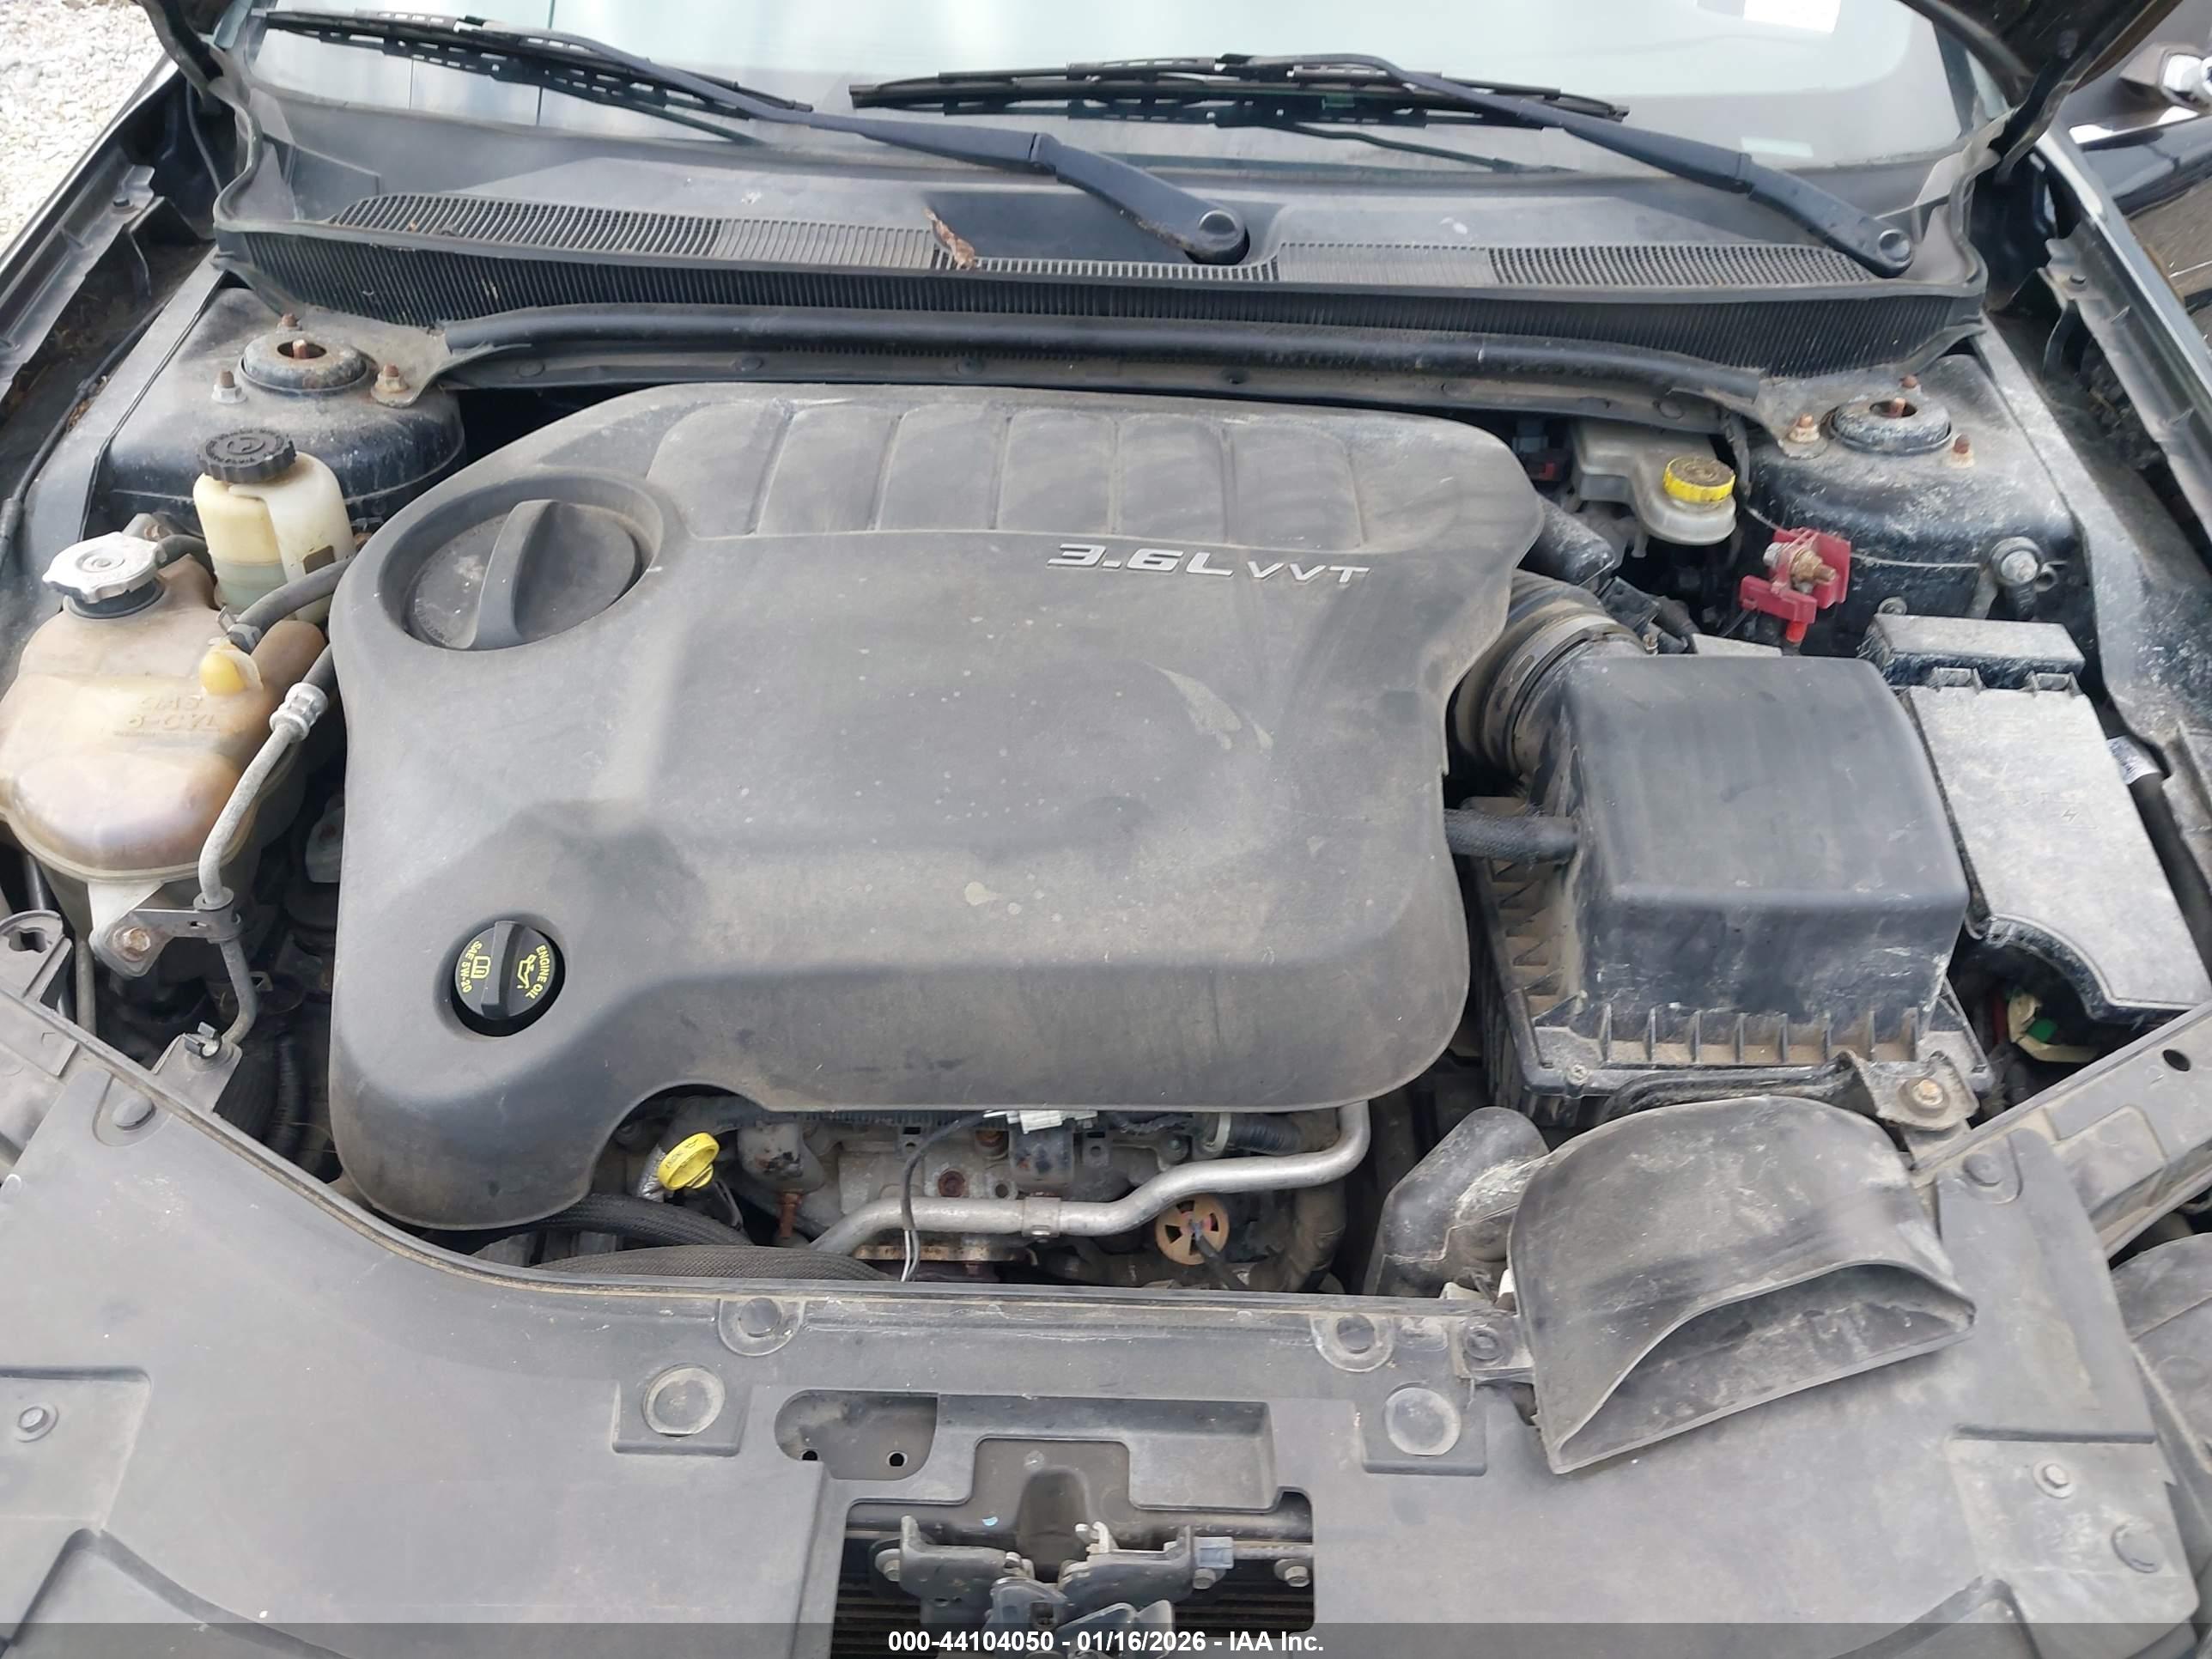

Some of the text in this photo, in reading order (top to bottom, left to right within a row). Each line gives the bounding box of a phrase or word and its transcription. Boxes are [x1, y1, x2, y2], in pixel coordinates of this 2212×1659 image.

[1047, 543, 1370, 585] 3.6L VVT
[459, 940, 483, 994] SAE 5W-20
[525, 945, 550, 1000] ENGINE OIL
